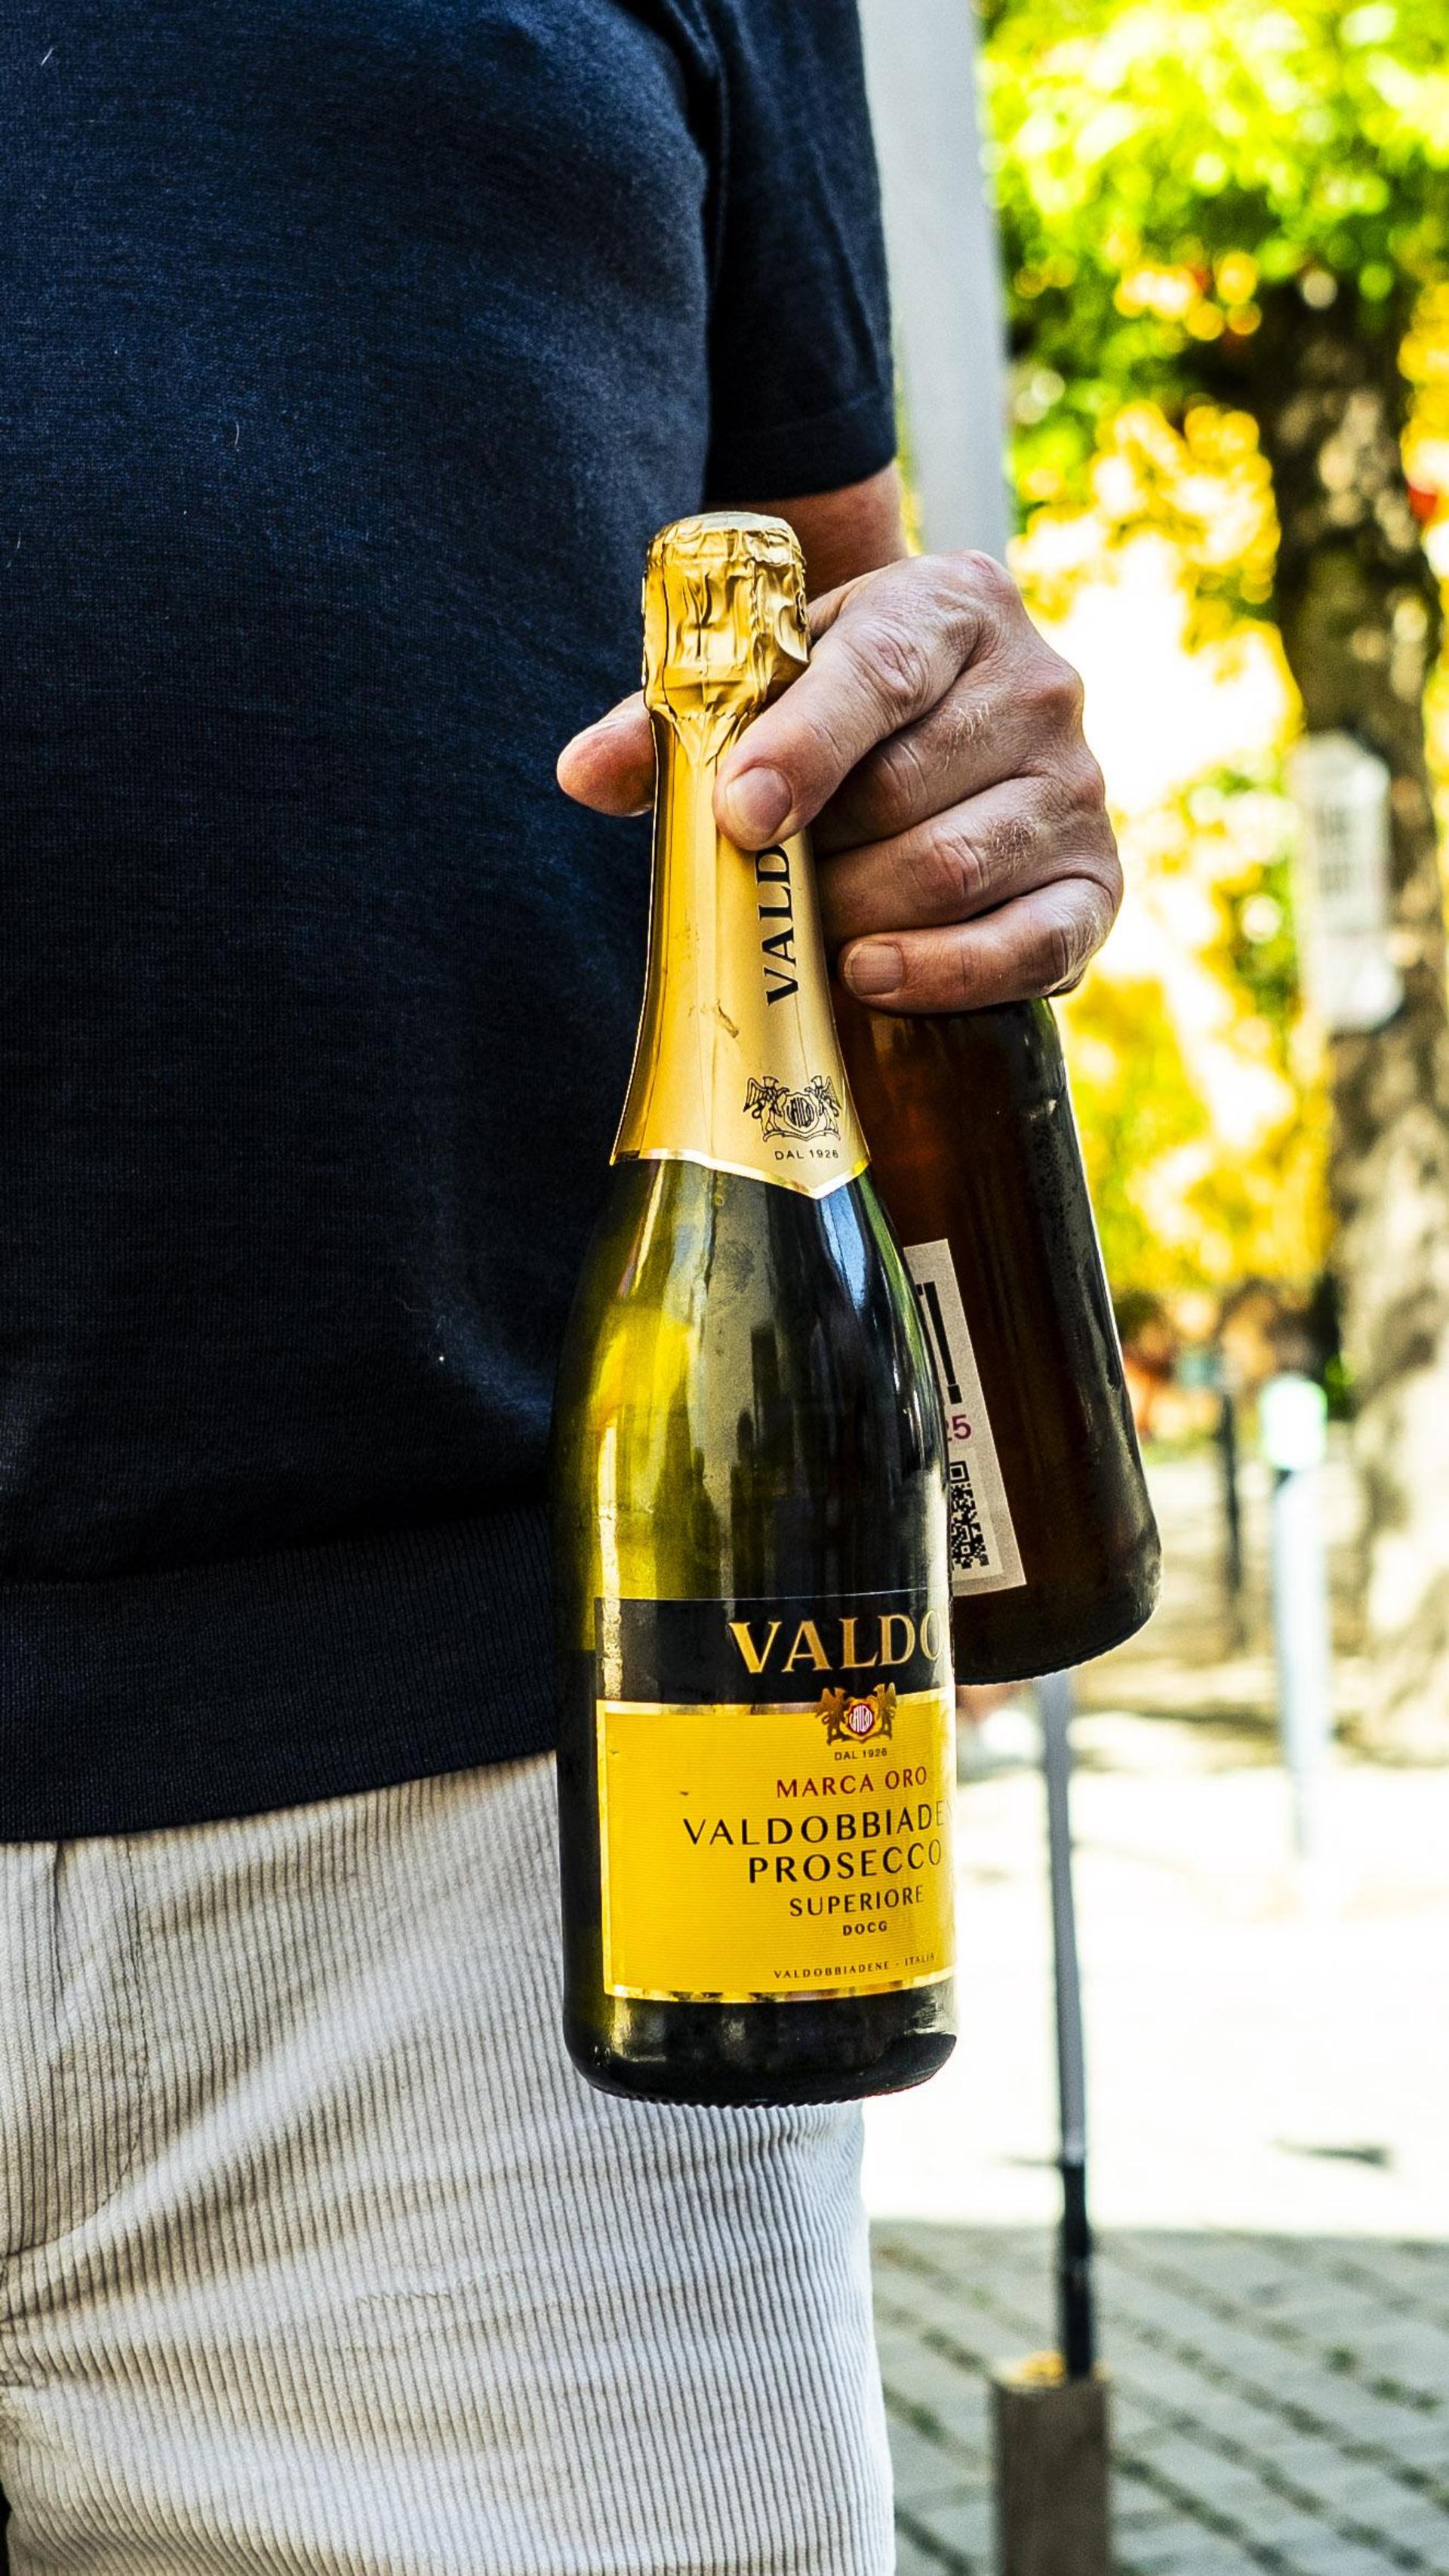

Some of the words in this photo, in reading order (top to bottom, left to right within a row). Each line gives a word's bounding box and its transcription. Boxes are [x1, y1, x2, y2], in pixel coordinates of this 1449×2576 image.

[774, 1150, 804, 1160] DAL
[810, 1149, 839, 1159] 1926
[834, 1751, 857, 1760] DAL
[777, 1774, 874, 1798] MARCA
[885, 1766, 927, 1789] ORO
[749, 1839, 941, 1883] PROSECCO
[789, 1885, 924, 1917] SUPERIORE
[843, 1921, 887, 1936] DOCG
[774, 1961, 888, 1978] VALDOBBIADENE
